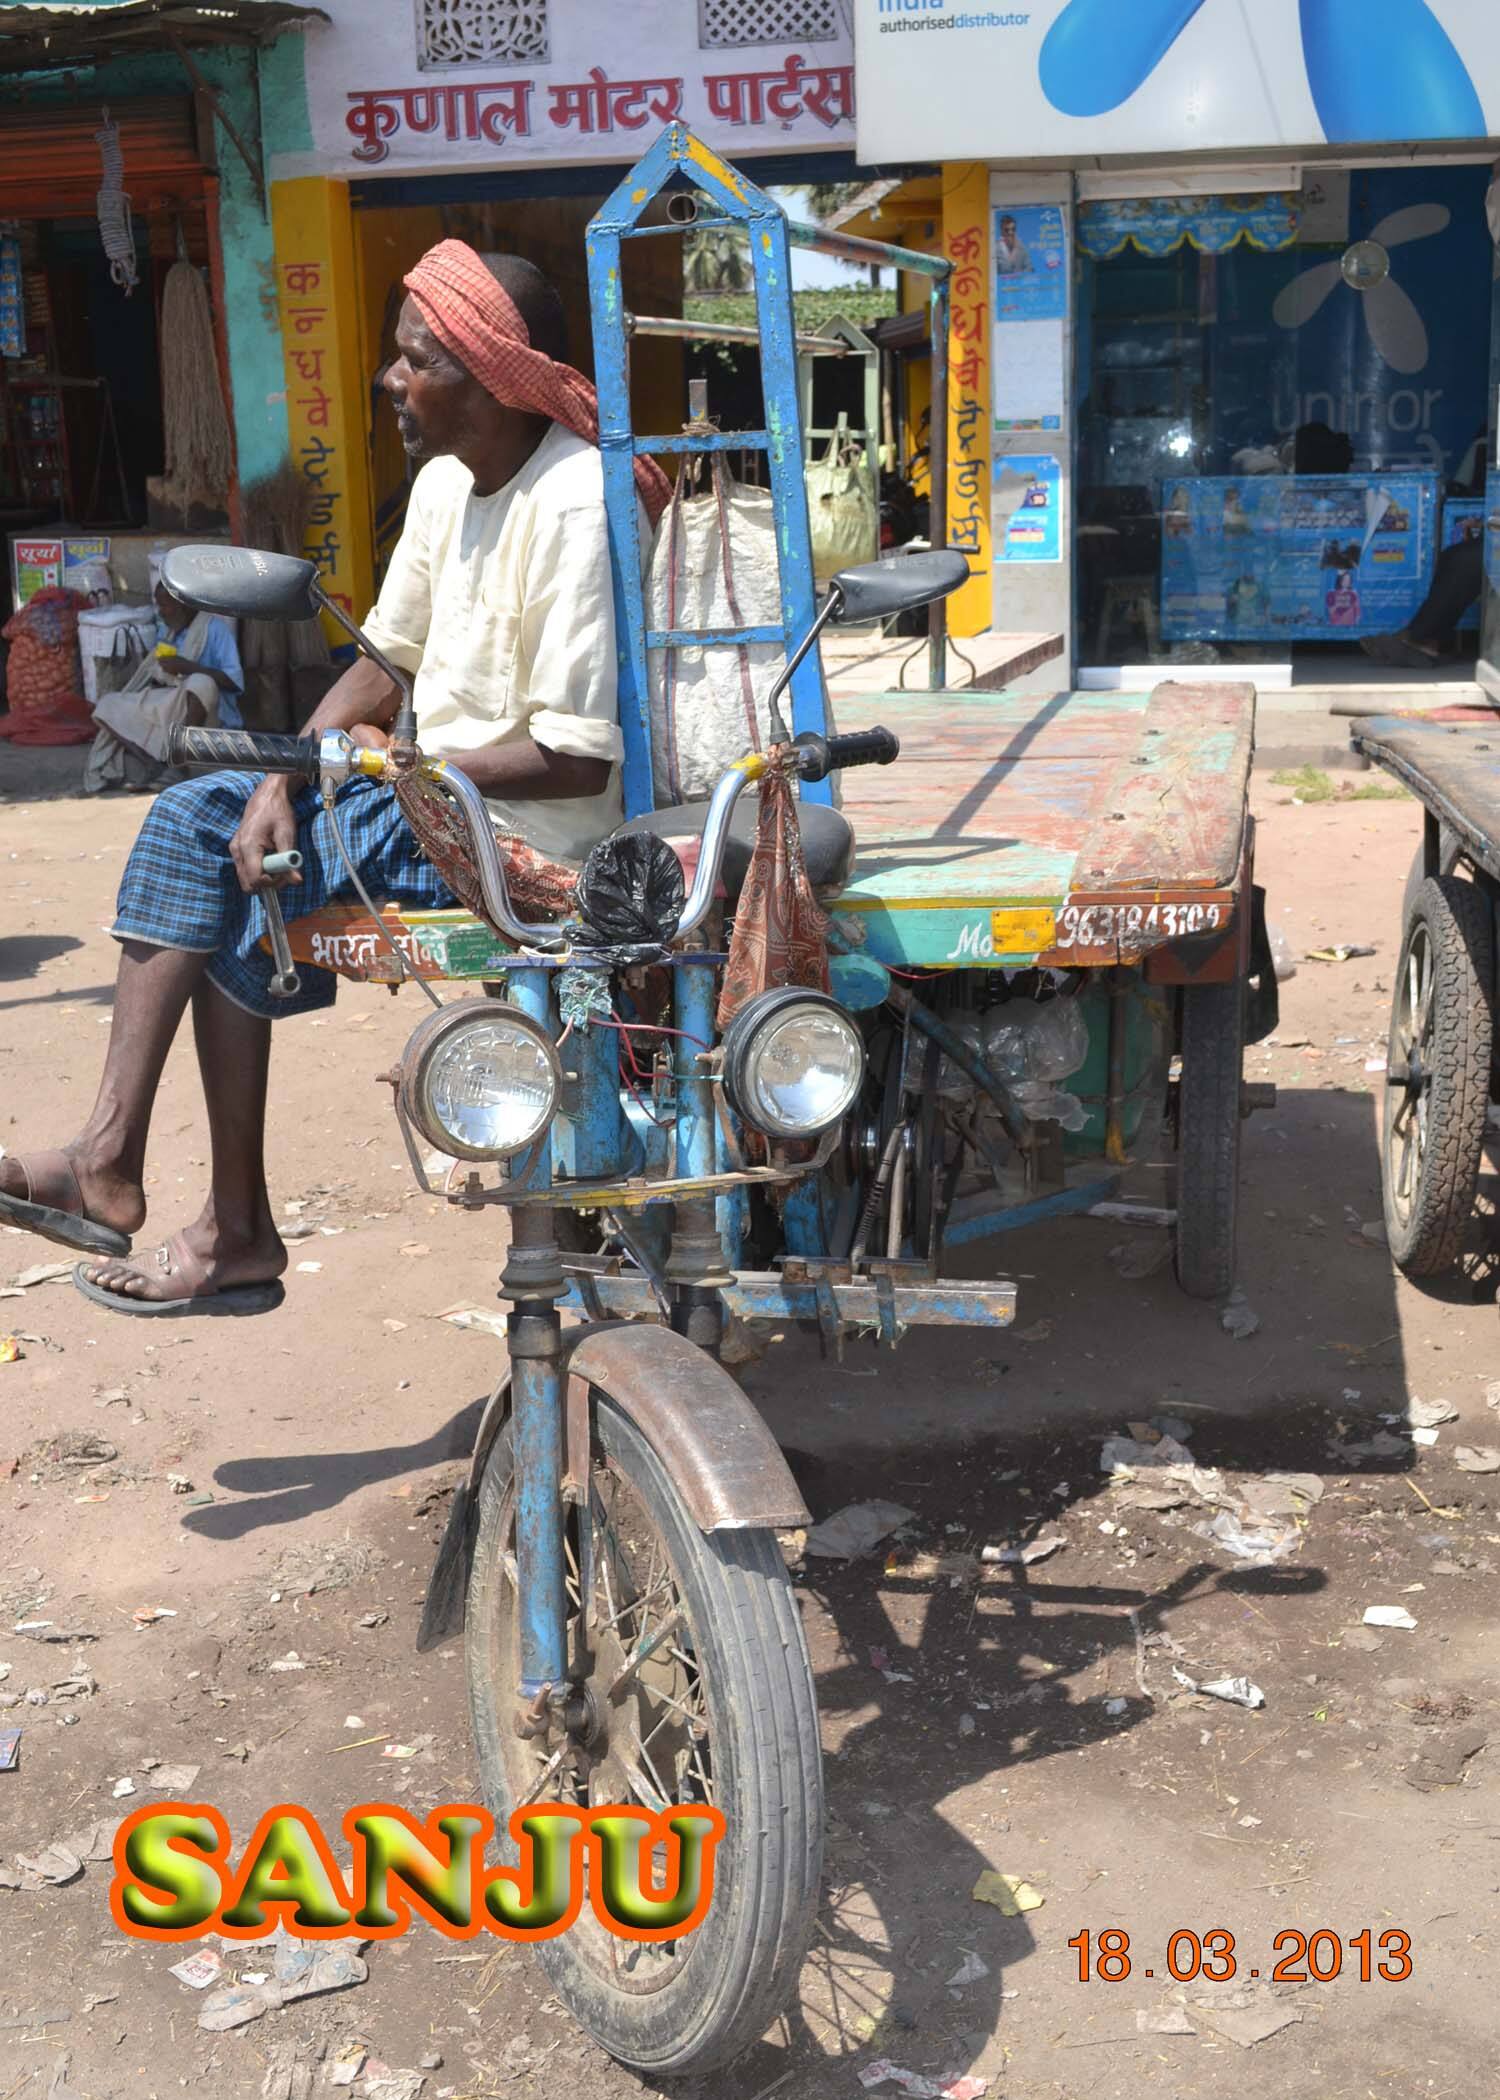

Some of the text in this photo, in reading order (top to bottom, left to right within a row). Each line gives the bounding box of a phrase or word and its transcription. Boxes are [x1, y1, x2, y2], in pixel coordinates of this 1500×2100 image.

[345, 80, 533, 164] कुणाल
[548, 67, 685, 133] मोटर
[311, 932, 381, 968] भारत
